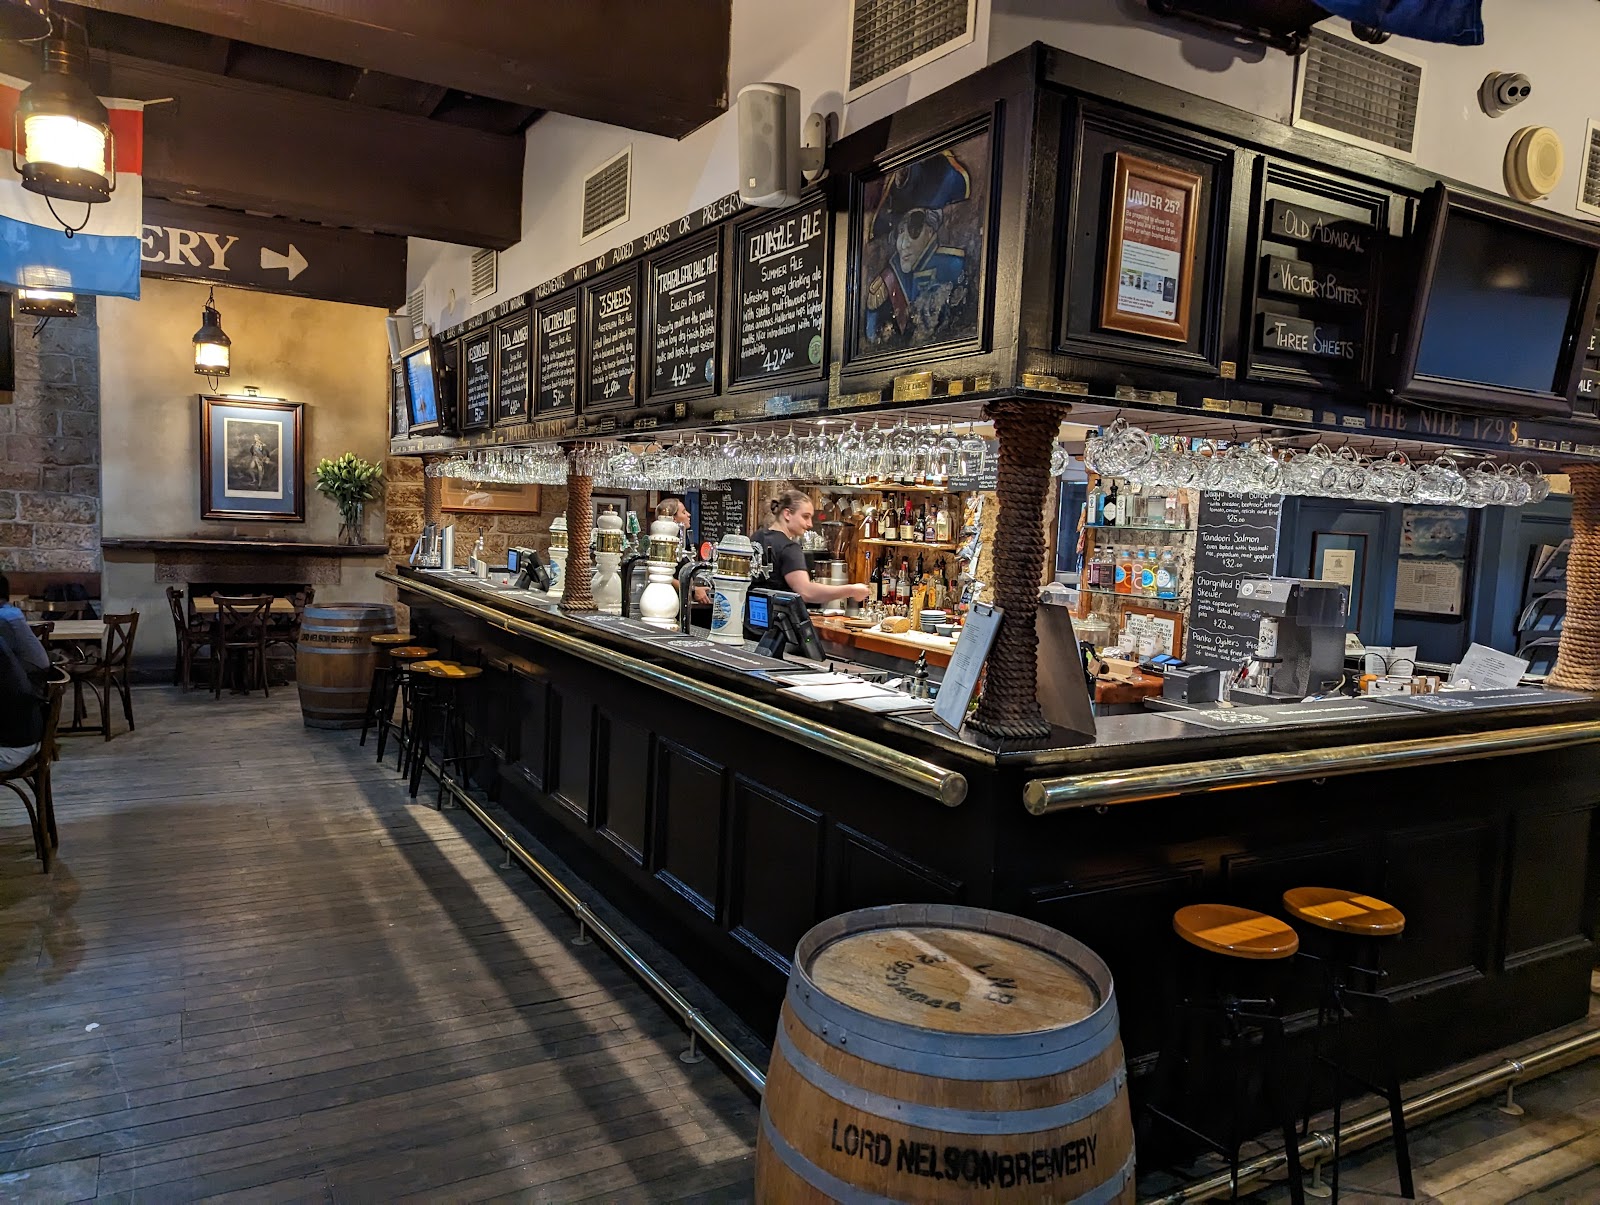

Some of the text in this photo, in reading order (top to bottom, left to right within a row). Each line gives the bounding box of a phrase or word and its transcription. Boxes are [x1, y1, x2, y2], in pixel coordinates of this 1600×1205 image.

[1127, 188, 1180, 215] UNDER 25?
[800, 209, 822, 243] ALE
[1125, 218, 1136, 226] prove
[1156, 225, 1166, 233] least
[1132, 212, 1150, 222] prepared
[1154, 217, 1165, 225] show
[1151, 231, 1164, 241] buying
[1284, 209, 1364, 253] OLD ADMIRAL
[574, 263, 588, 281] WITH
[595, 256, 605, 272] NO
[612, 241, 634, 265] ADDED
[643, 224, 670, 251] SUGARS
[679, 215, 691, 235] OR
[658, 251, 718, 294] TRAFALGAR PALE ALE
[771, 284, 787, 297] easy
[787, 273, 811, 291] drinking
[812, 265, 822, 281] ale
[1280, 263, 1362, 306] VICTORY BITTER
[599, 285, 632, 317] 3 SHEETS
[756, 303, 770, 318] subtle
[806, 283, 820, 300] and
[685, 316, 690, 324] on
[796, 306, 806, 318] hops
[678, 329, 686, 343] dry
[756, 330, 766, 342] Nice
[767, 323, 796, 339] introduction
[1274, 321, 1355, 359] THREE SHEETS
[505, 419, 567, 442] TRAFALGAR 1805
[1368, 402, 1520, 445] THE NILE 1798
[1201, 532, 1260, 543] Tandoori Salmon
[1253, 553, 1276, 563] yoghurt
[1197, 575, 1233, 592] Chargrilled
[1197, 587, 1223, 599] Skewer
[1198, 604, 1214, 612] potato
[1192, 631, 1240, 648] Panko Oysters
[1229, 648, 1242, 657] fried
[831, 1118, 1098, 1190] LORD NELSON BREWERY
